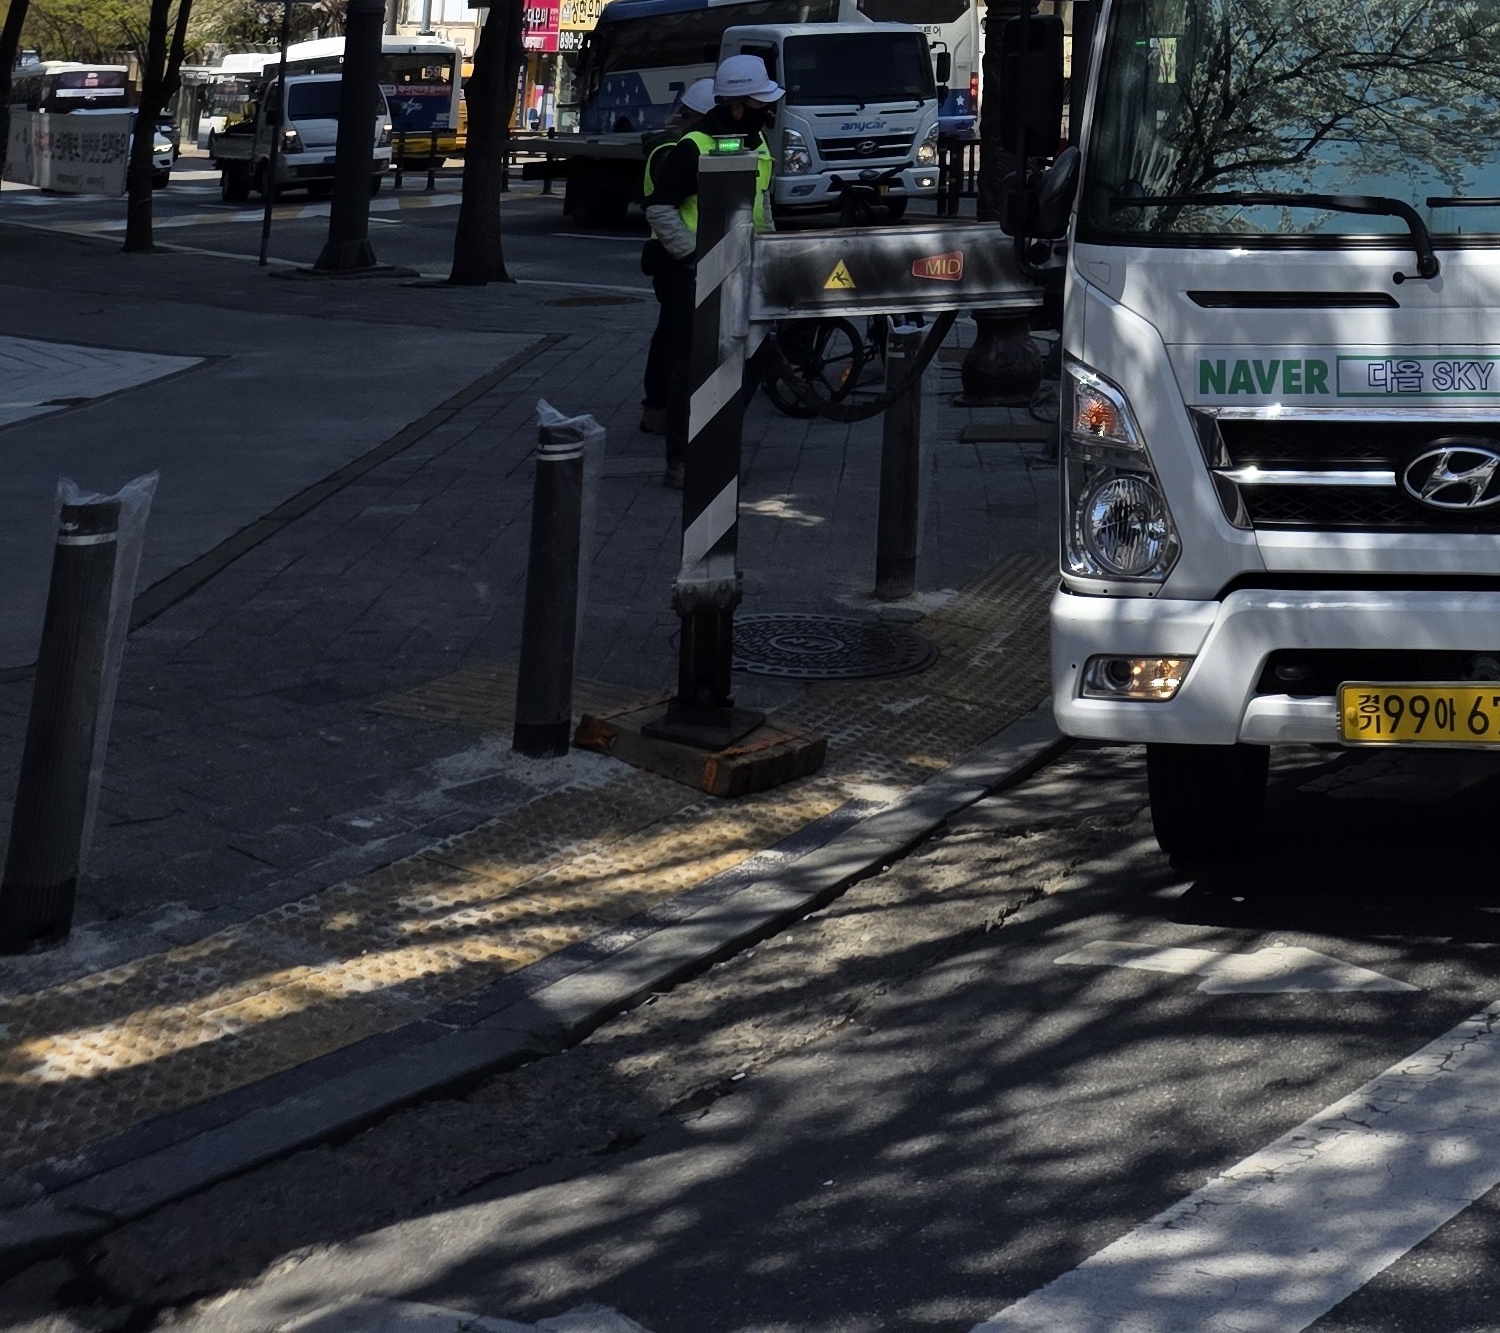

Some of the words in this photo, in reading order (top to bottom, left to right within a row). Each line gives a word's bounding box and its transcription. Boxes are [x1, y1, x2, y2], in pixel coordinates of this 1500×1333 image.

[925, 257, 961, 276] MID
[1199, 359, 1330, 395] NAVER
[1368, 360, 1424, 393] 다올
[1432, 361, 1495, 391] SKY
